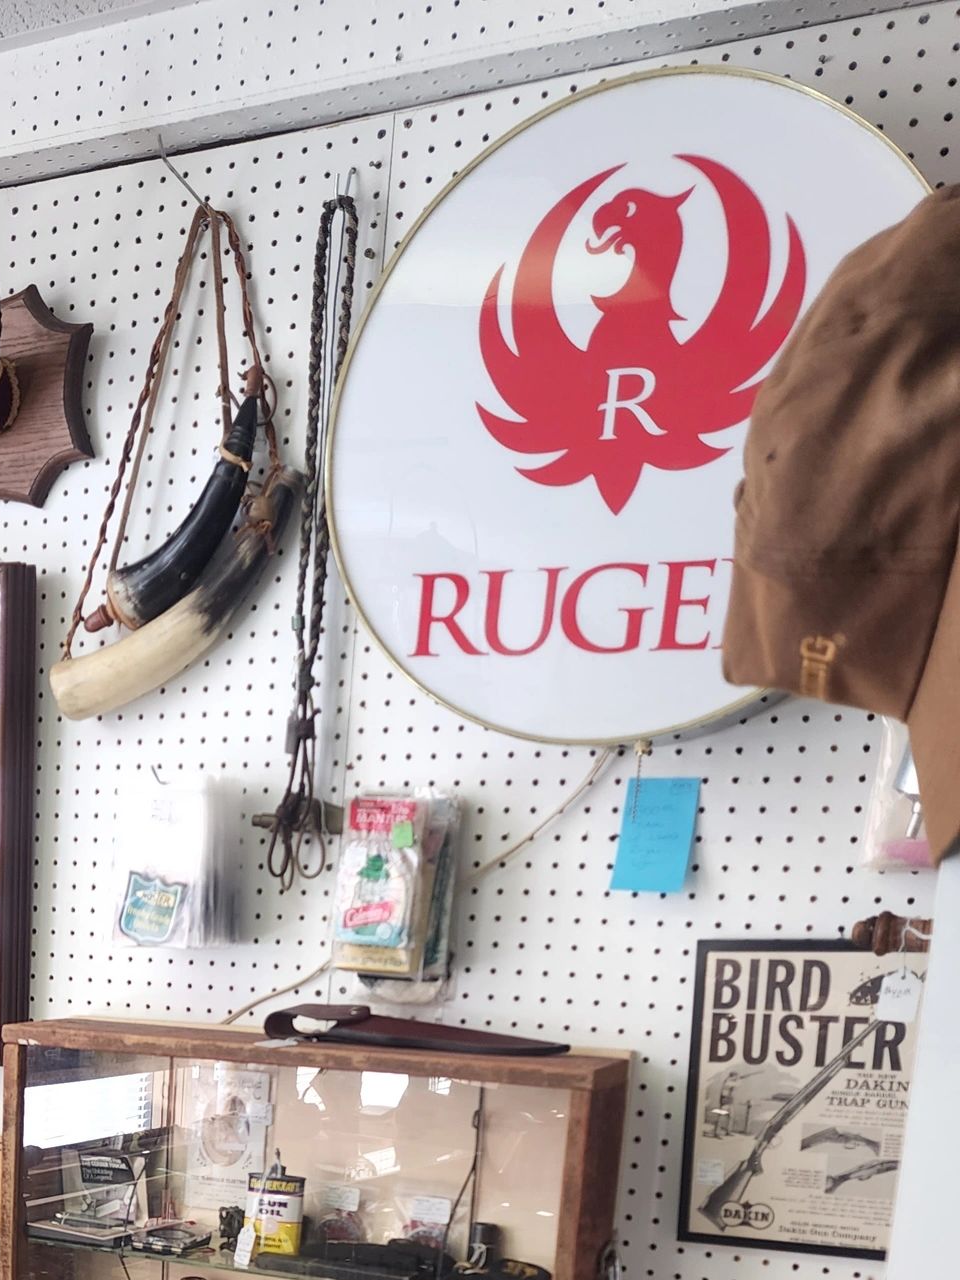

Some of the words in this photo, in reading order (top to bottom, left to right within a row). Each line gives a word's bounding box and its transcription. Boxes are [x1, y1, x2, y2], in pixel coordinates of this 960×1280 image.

[597, 366, 668, 440] R
[407, 557, 737, 658] RUGE
[712, 958, 832, 1013] BIRD
[707, 1012, 907, 1072] BUSTER
[845, 1078, 910, 1092] DAKIN
[825, 1096, 871, 1107] TRAP
[876, 1098, 909, 1110] GUN
[258, 1208, 284, 1217] OIL
[723, 1208, 770, 1222] DAKIN
